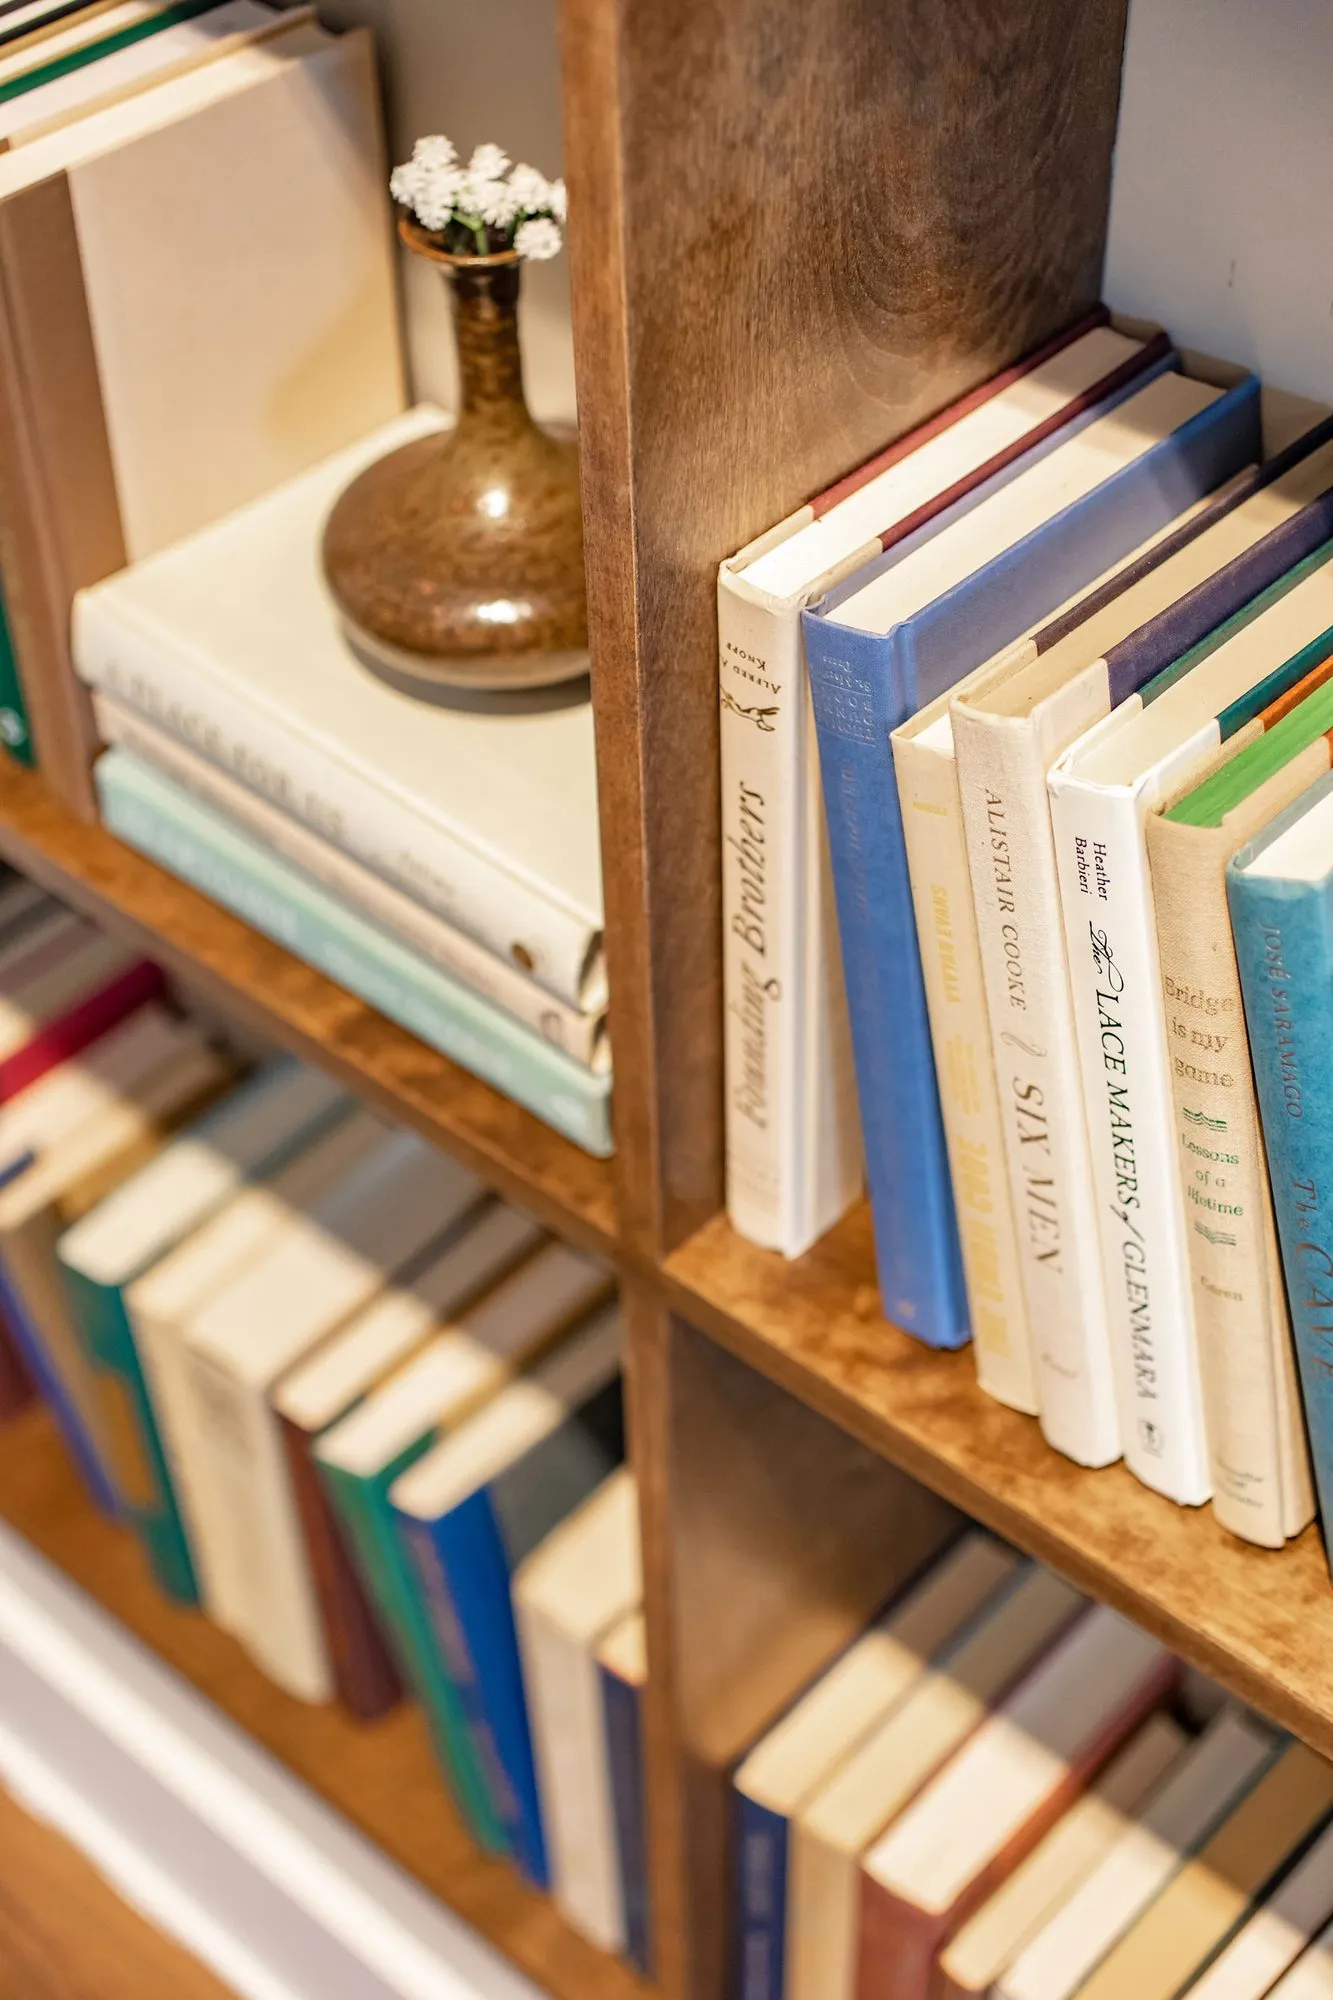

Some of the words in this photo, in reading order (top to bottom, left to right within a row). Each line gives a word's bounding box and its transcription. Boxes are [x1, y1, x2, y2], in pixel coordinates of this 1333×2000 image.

[726, 642, 767, 672] KNOPF
[731, 665, 782, 695] ALFRED
[727, 780, 767, 957] Brothers
[1075, 836, 1092, 895] Barbieri
[1093, 841, 1111, 901] Heather
[984, 788, 1016, 914] ALISTAIR
[1001, 921, 1028, 1012] COOKE
[1089, 920, 1124, 993] The
[1165, 975, 1234, 1016] Bridge
[1095, 989, 1129, 1076] LACE
[1271, 987, 1304, 1119] SARAMAGO
[1174, 1056, 1234, 1088] game
[1012, 1075, 1050, 1157] SIX
[1106, 1079, 1140, 1210] MAKERS
[1182, 1133, 1240, 1165] Lessons
[1195, 1170, 1211, 1185] of
[1024, 1166, 1063, 1275] MEN
[1188, 1184, 1244, 1217] lifetime
[1293, 1178, 1317, 1232] The
[1121, 1240, 1159, 1402] GLENMARA
